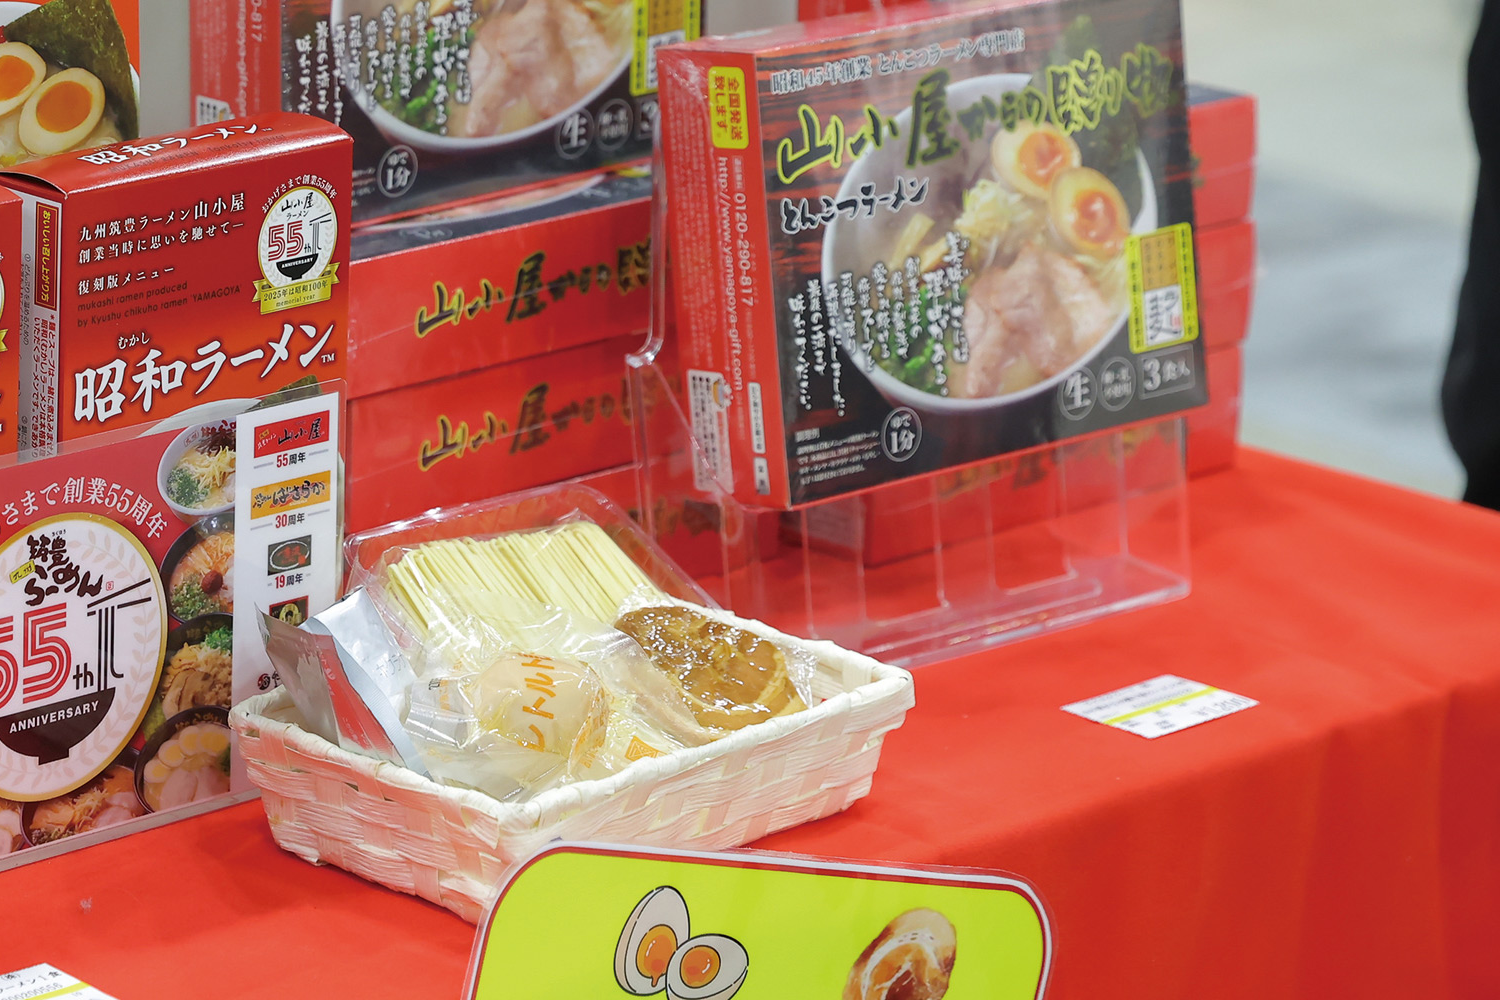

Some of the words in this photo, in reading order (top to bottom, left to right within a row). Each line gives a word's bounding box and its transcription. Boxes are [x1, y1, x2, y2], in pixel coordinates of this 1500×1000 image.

[770, 55, 874, 95] 昭和45年創業
[877, 27, 1027, 76] とんこつラーメン専門店
[727, 78, 745, 142] 全国発送
[77, 123, 259, 166] 昭和ラーメン
[79, 193, 245, 243] 九州筑豊ラーメン山小屋
[780, 175, 931, 235] とんこつラーメン
[39, 210, 52, 302] おいしい召し上がり方
[282, 256, 313, 269] ANNIVERSARY
[734, 192, 755, 307] 0120-290-817
[78, 266, 175, 295] 復刻版メニュー
[264, 280, 329, 302] 2025年は昭和100年
[717, 156, 745, 392] http://www.yamagoya-gift.com
[118, 331, 150, 349] むかし
[74, 324, 334, 422] 昭和ラーメン
[1063, 370, 1092, 411] 生
[276, 451, 306, 468] 55周年
[275, 512, 305, 529] 30周年
[274, 573, 304, 590] 19周年
[9, 701, 99, 735] ANNIVERSARY
